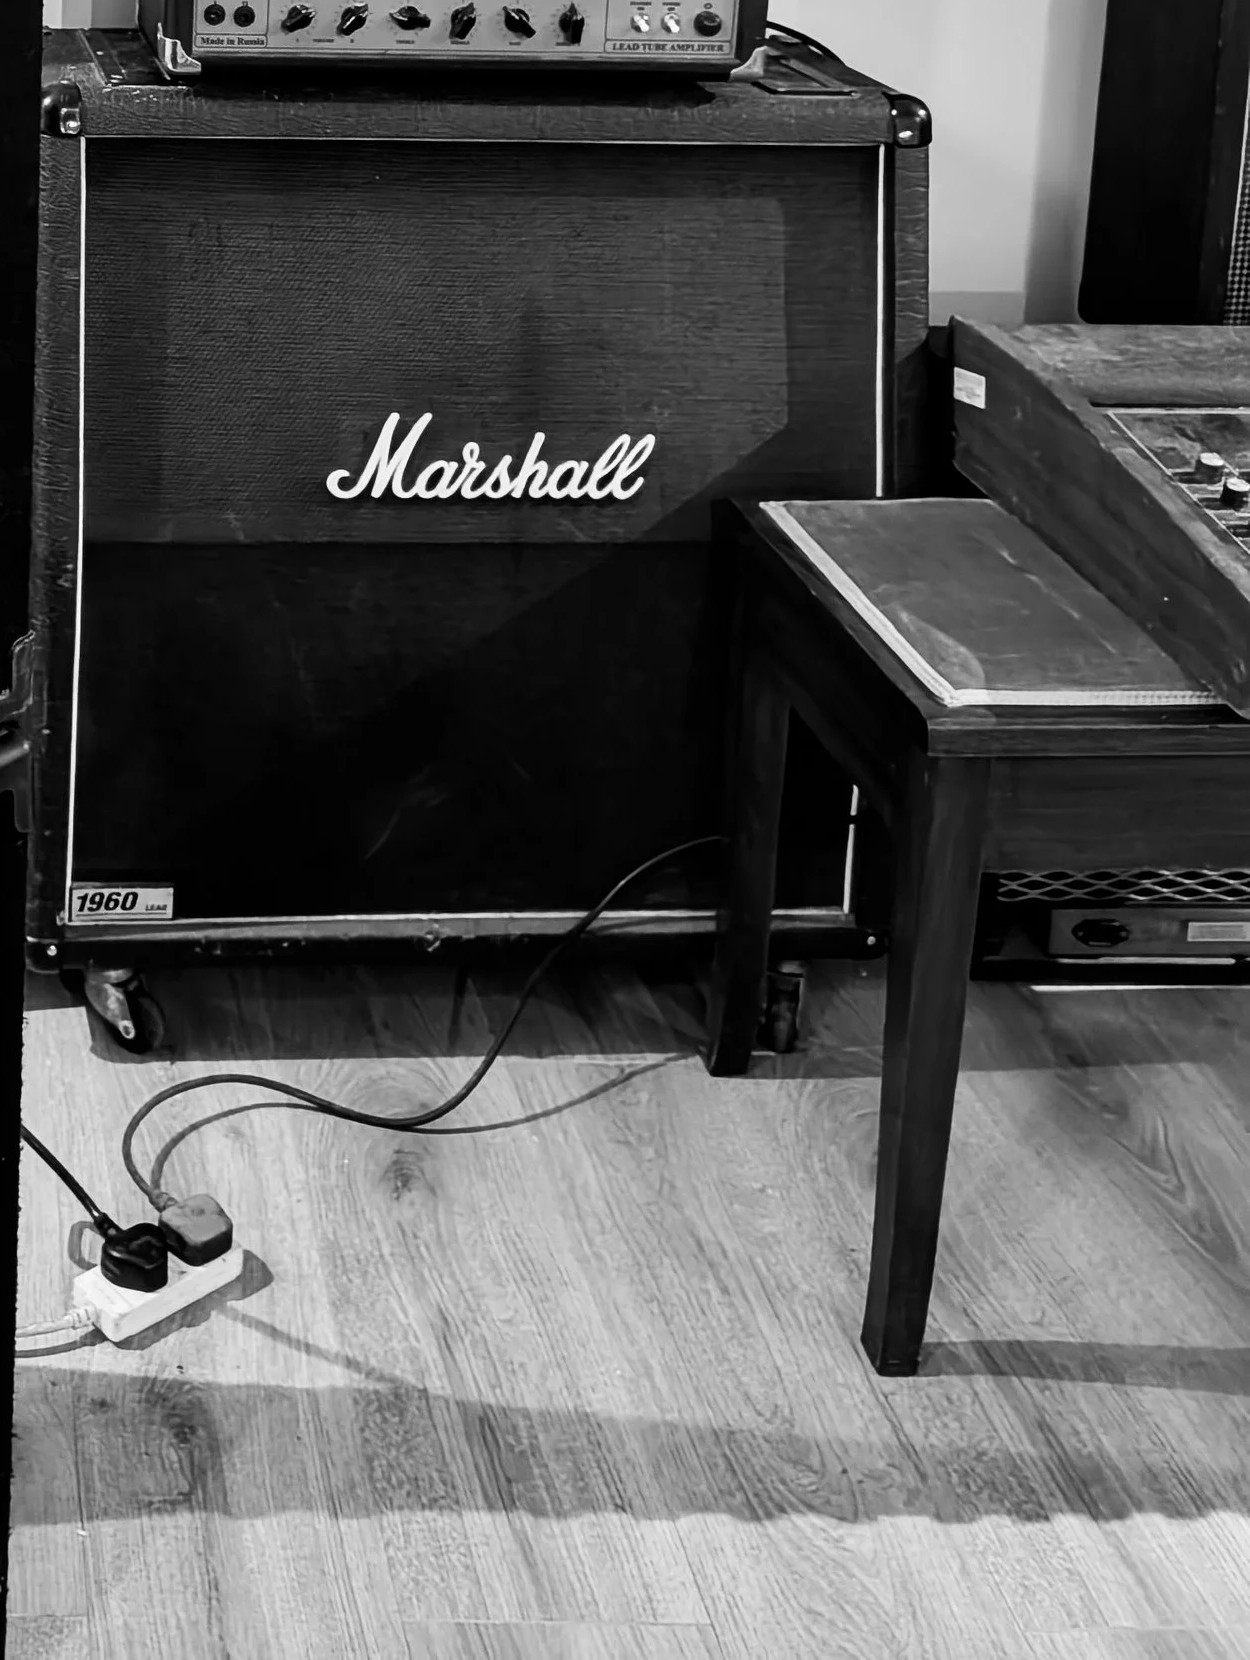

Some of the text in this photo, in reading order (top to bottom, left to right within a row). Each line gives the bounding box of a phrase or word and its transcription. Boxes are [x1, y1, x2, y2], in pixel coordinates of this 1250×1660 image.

[201, 37, 264, 46] Made in Russia
[613, 42, 725, 52] LEAD TUBE AMPLIFIER
[326, 412, 656, 500] Marshall
[76, 892, 139, 912] 1960
